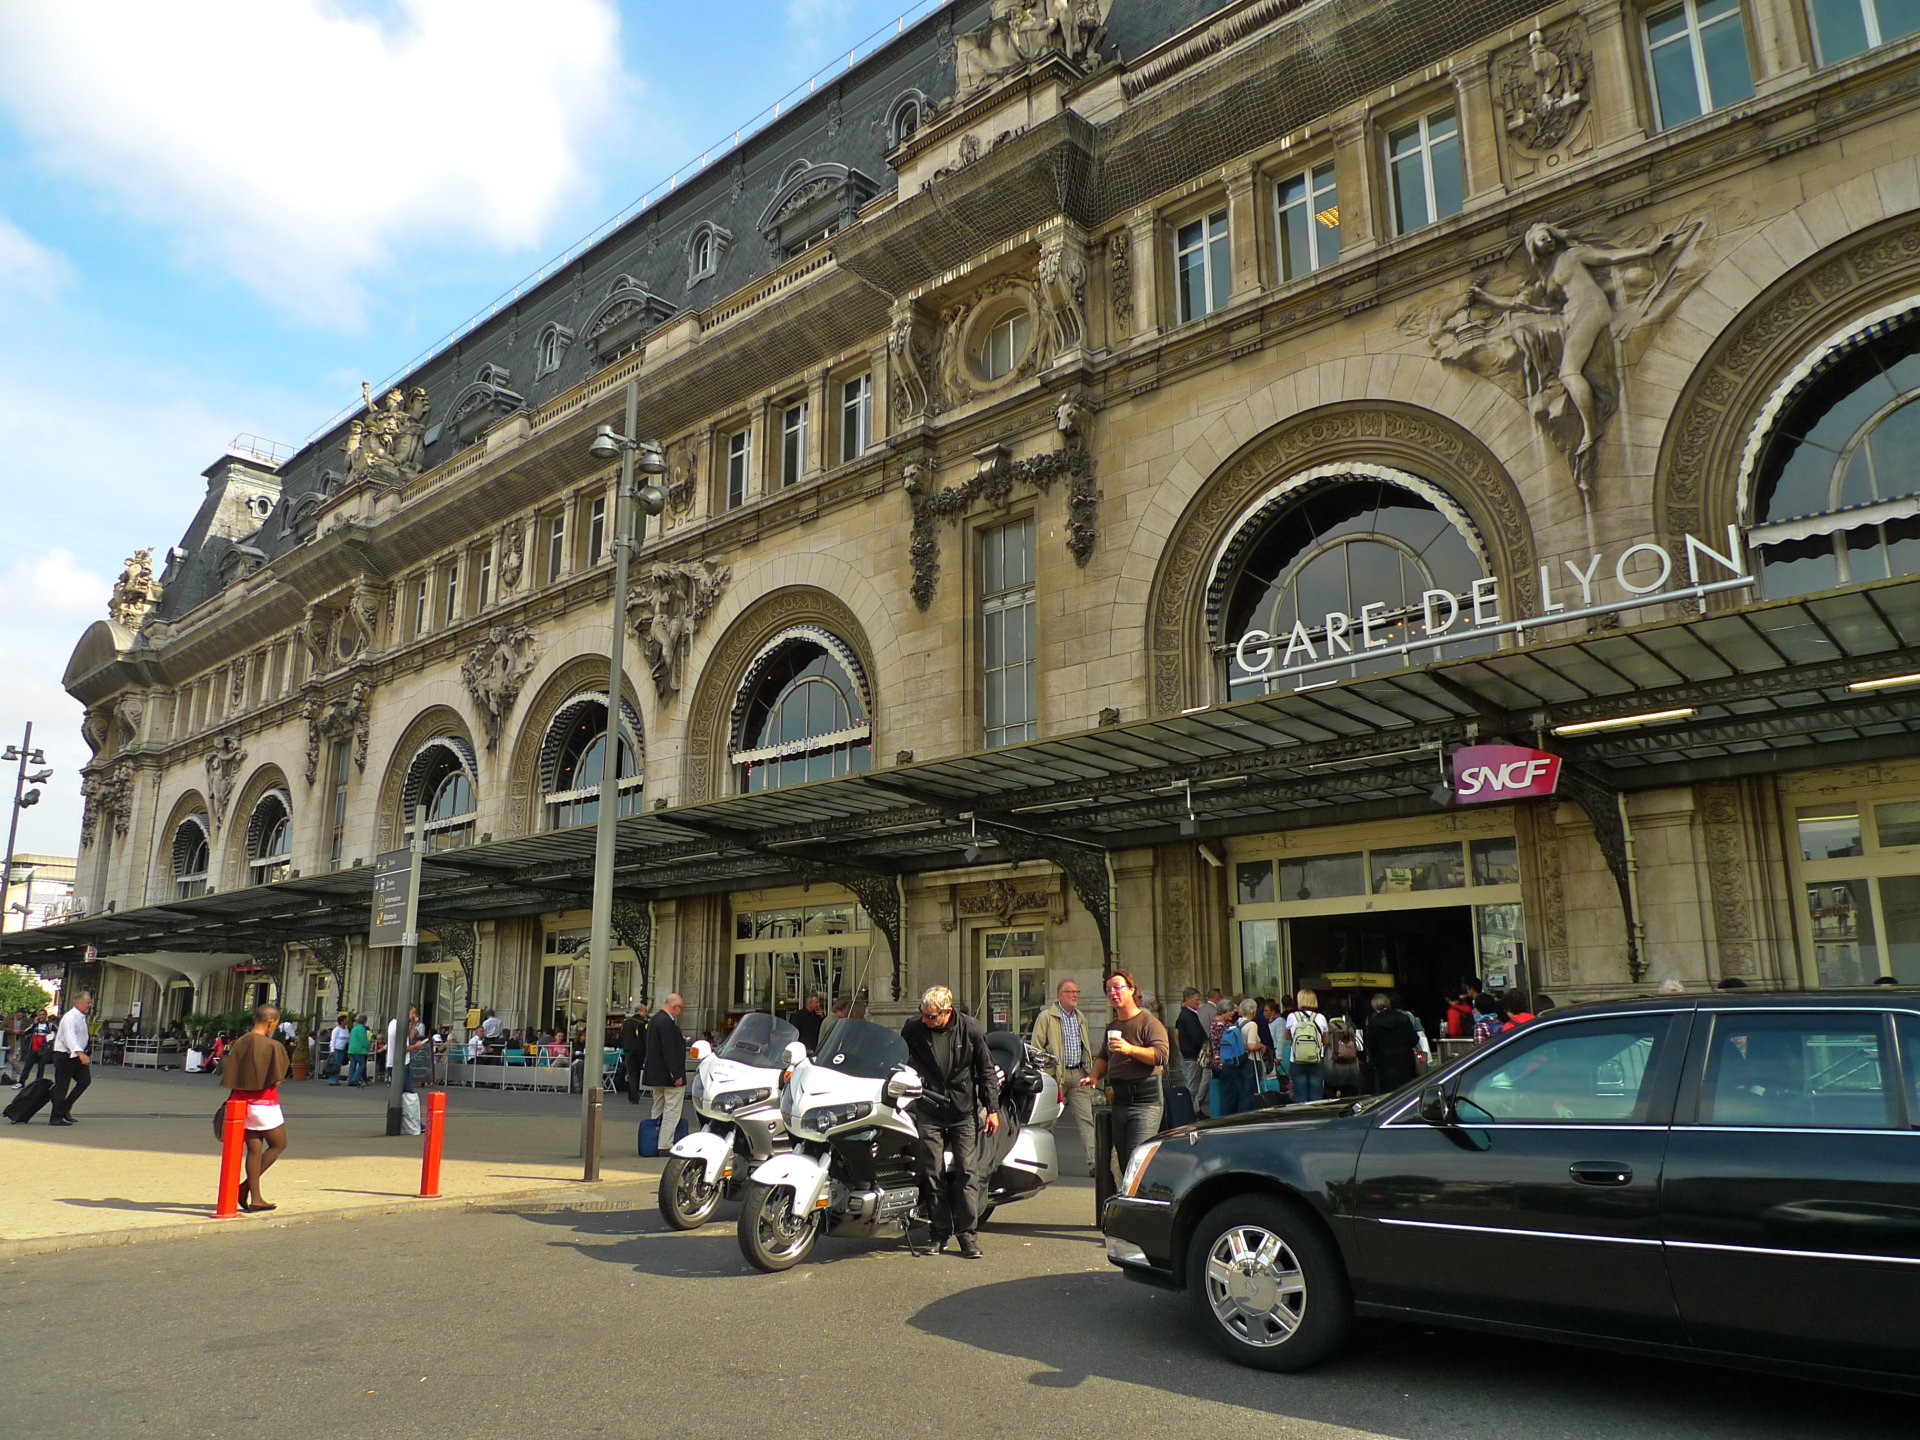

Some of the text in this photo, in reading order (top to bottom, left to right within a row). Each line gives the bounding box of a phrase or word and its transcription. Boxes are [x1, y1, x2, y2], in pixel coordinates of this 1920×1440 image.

[1236, 524, 1742, 673] GARE DE LYON
[1458, 758, 1551, 795] SNCF
